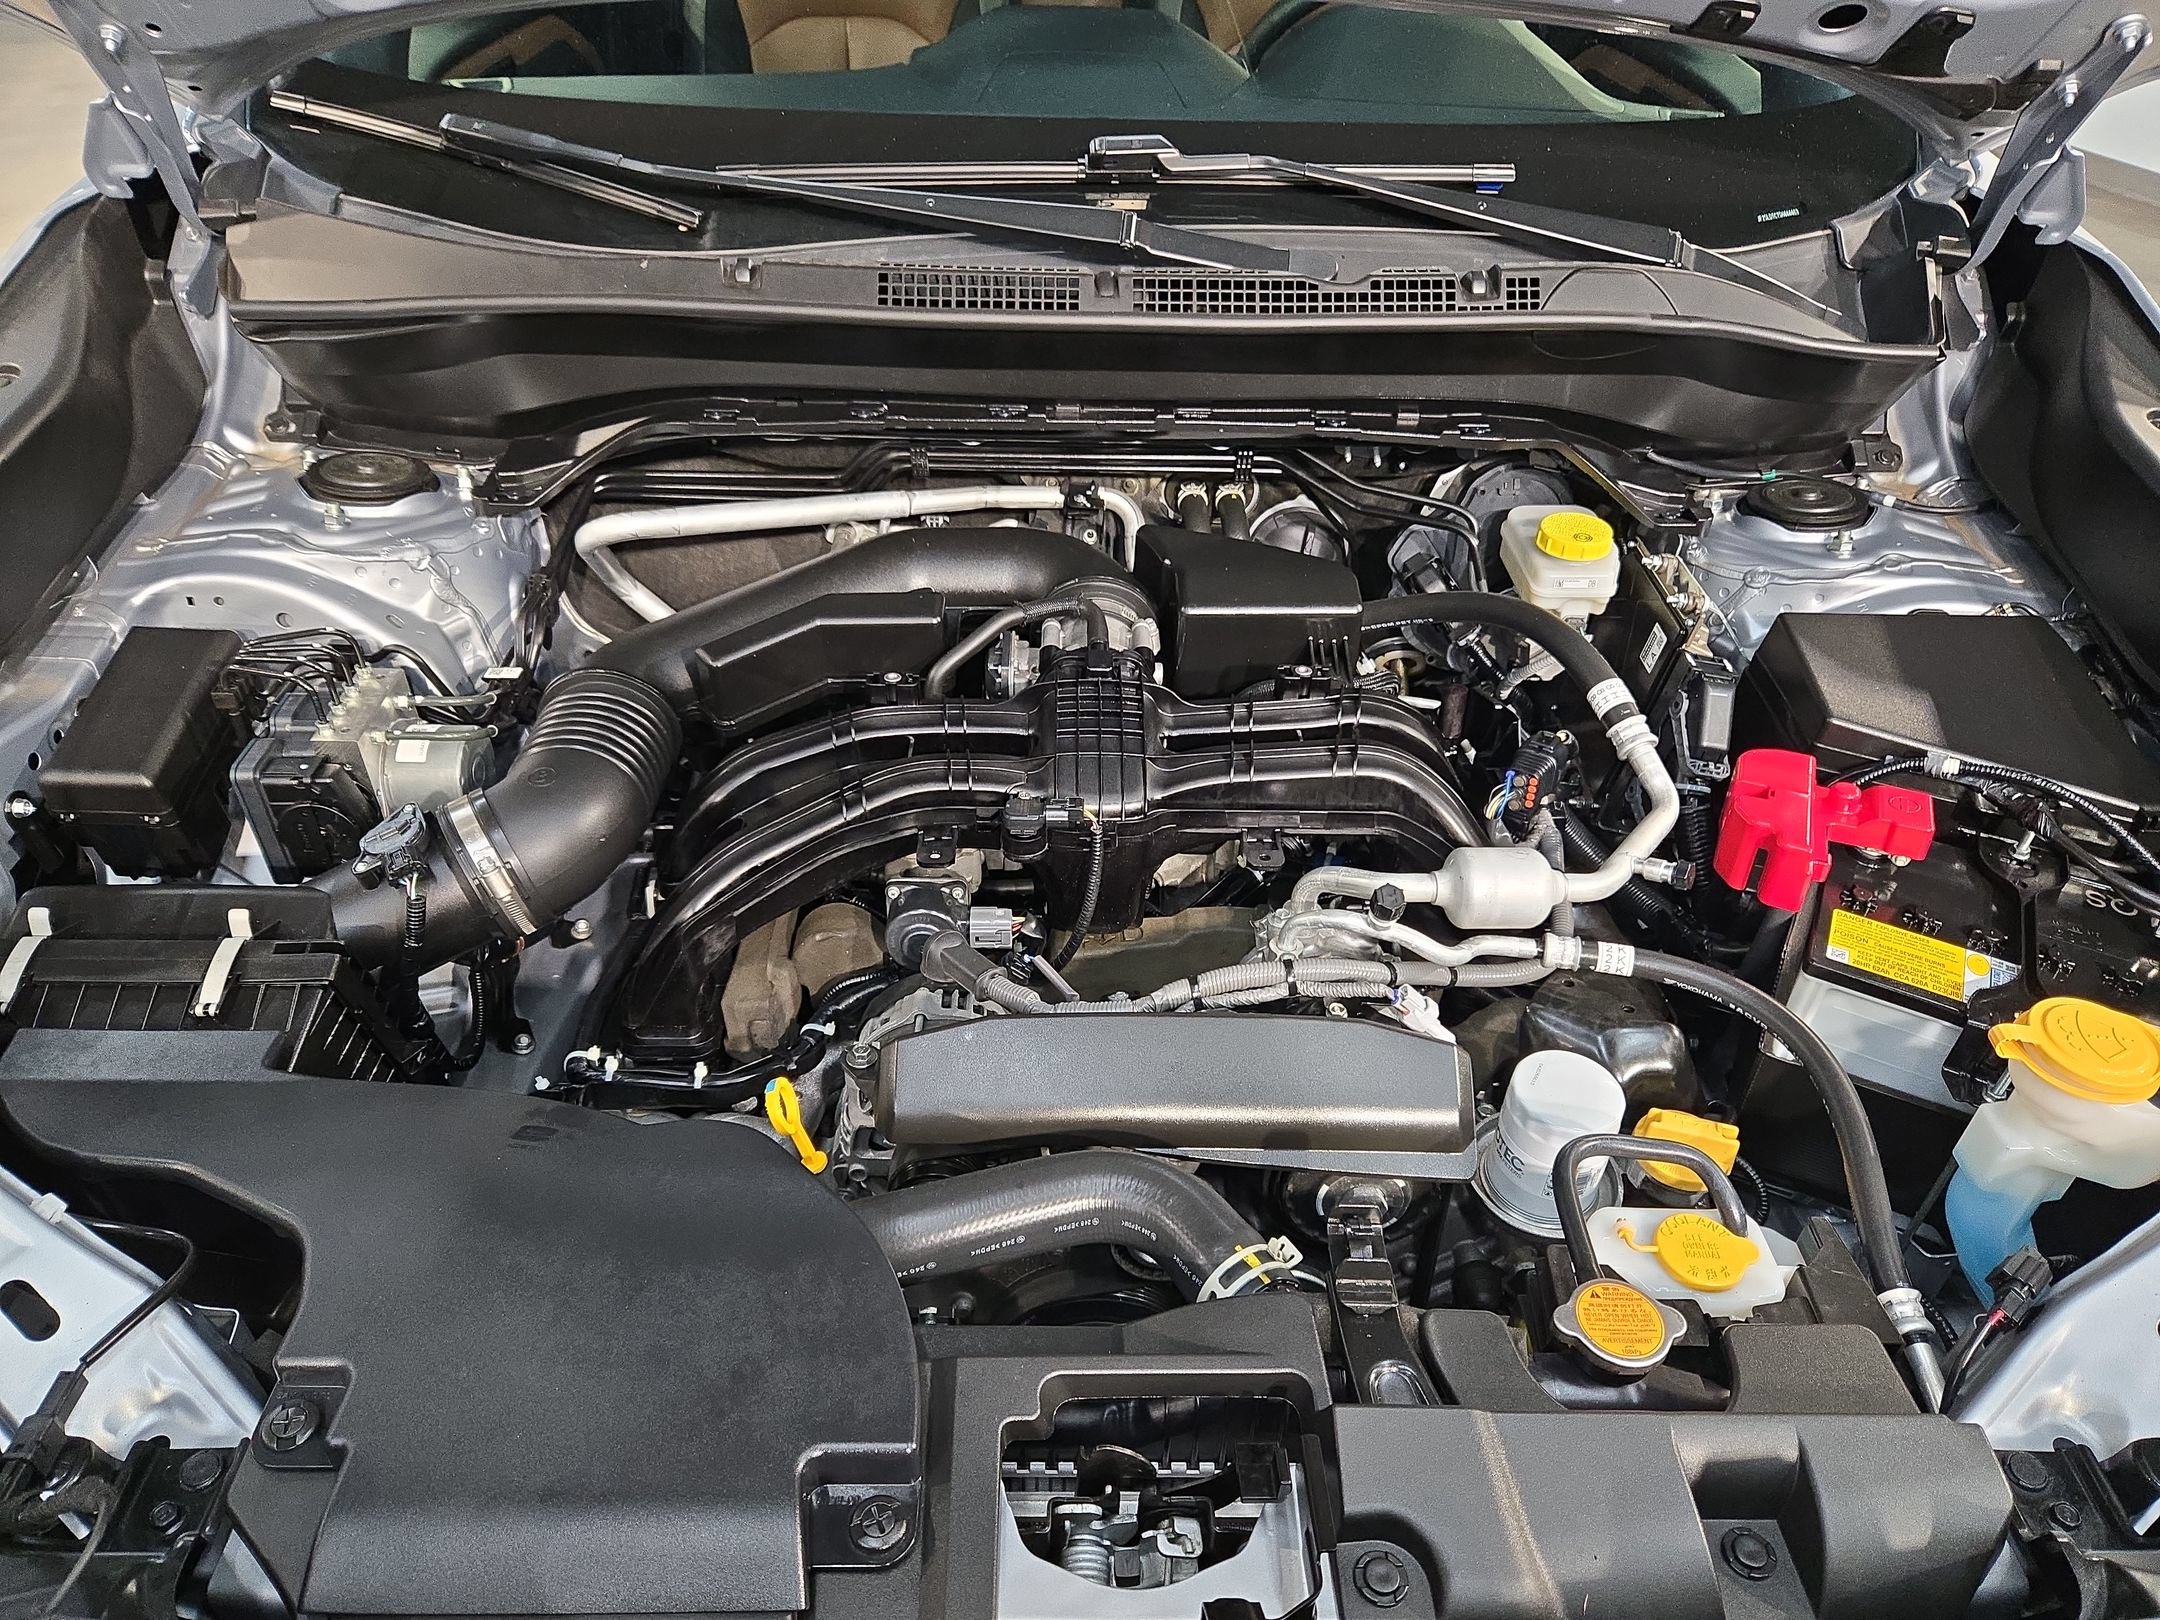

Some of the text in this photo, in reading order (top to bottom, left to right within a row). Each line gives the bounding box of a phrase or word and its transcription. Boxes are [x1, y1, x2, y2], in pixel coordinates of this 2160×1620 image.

[1836, 911, 1930, 944] DANGER EXPLOSIVE GASES
[1833, 929, 1946, 969] POISON CAUSES SEVERE BURNS
[1852, 959, 1871, 970] 20HR
[1893, 971, 1910, 983] CCA
[1932, 984, 1962, 999] D23(JIS)
[1857, 950, 1962, 987] KEEP VENT CAPS TIGHT AND LEVEL
[1857, 954, 1873, 963] KEEP
[1874, 959, 1886, 968] OUT
[1897, 966, 1919, 978] REACH
[1929, 976, 1961, 991] CHILDREN
[1676, 981, 1723, 1003] YOKOHAMA
[1660, 1215, 1730, 1237] COOLANT
